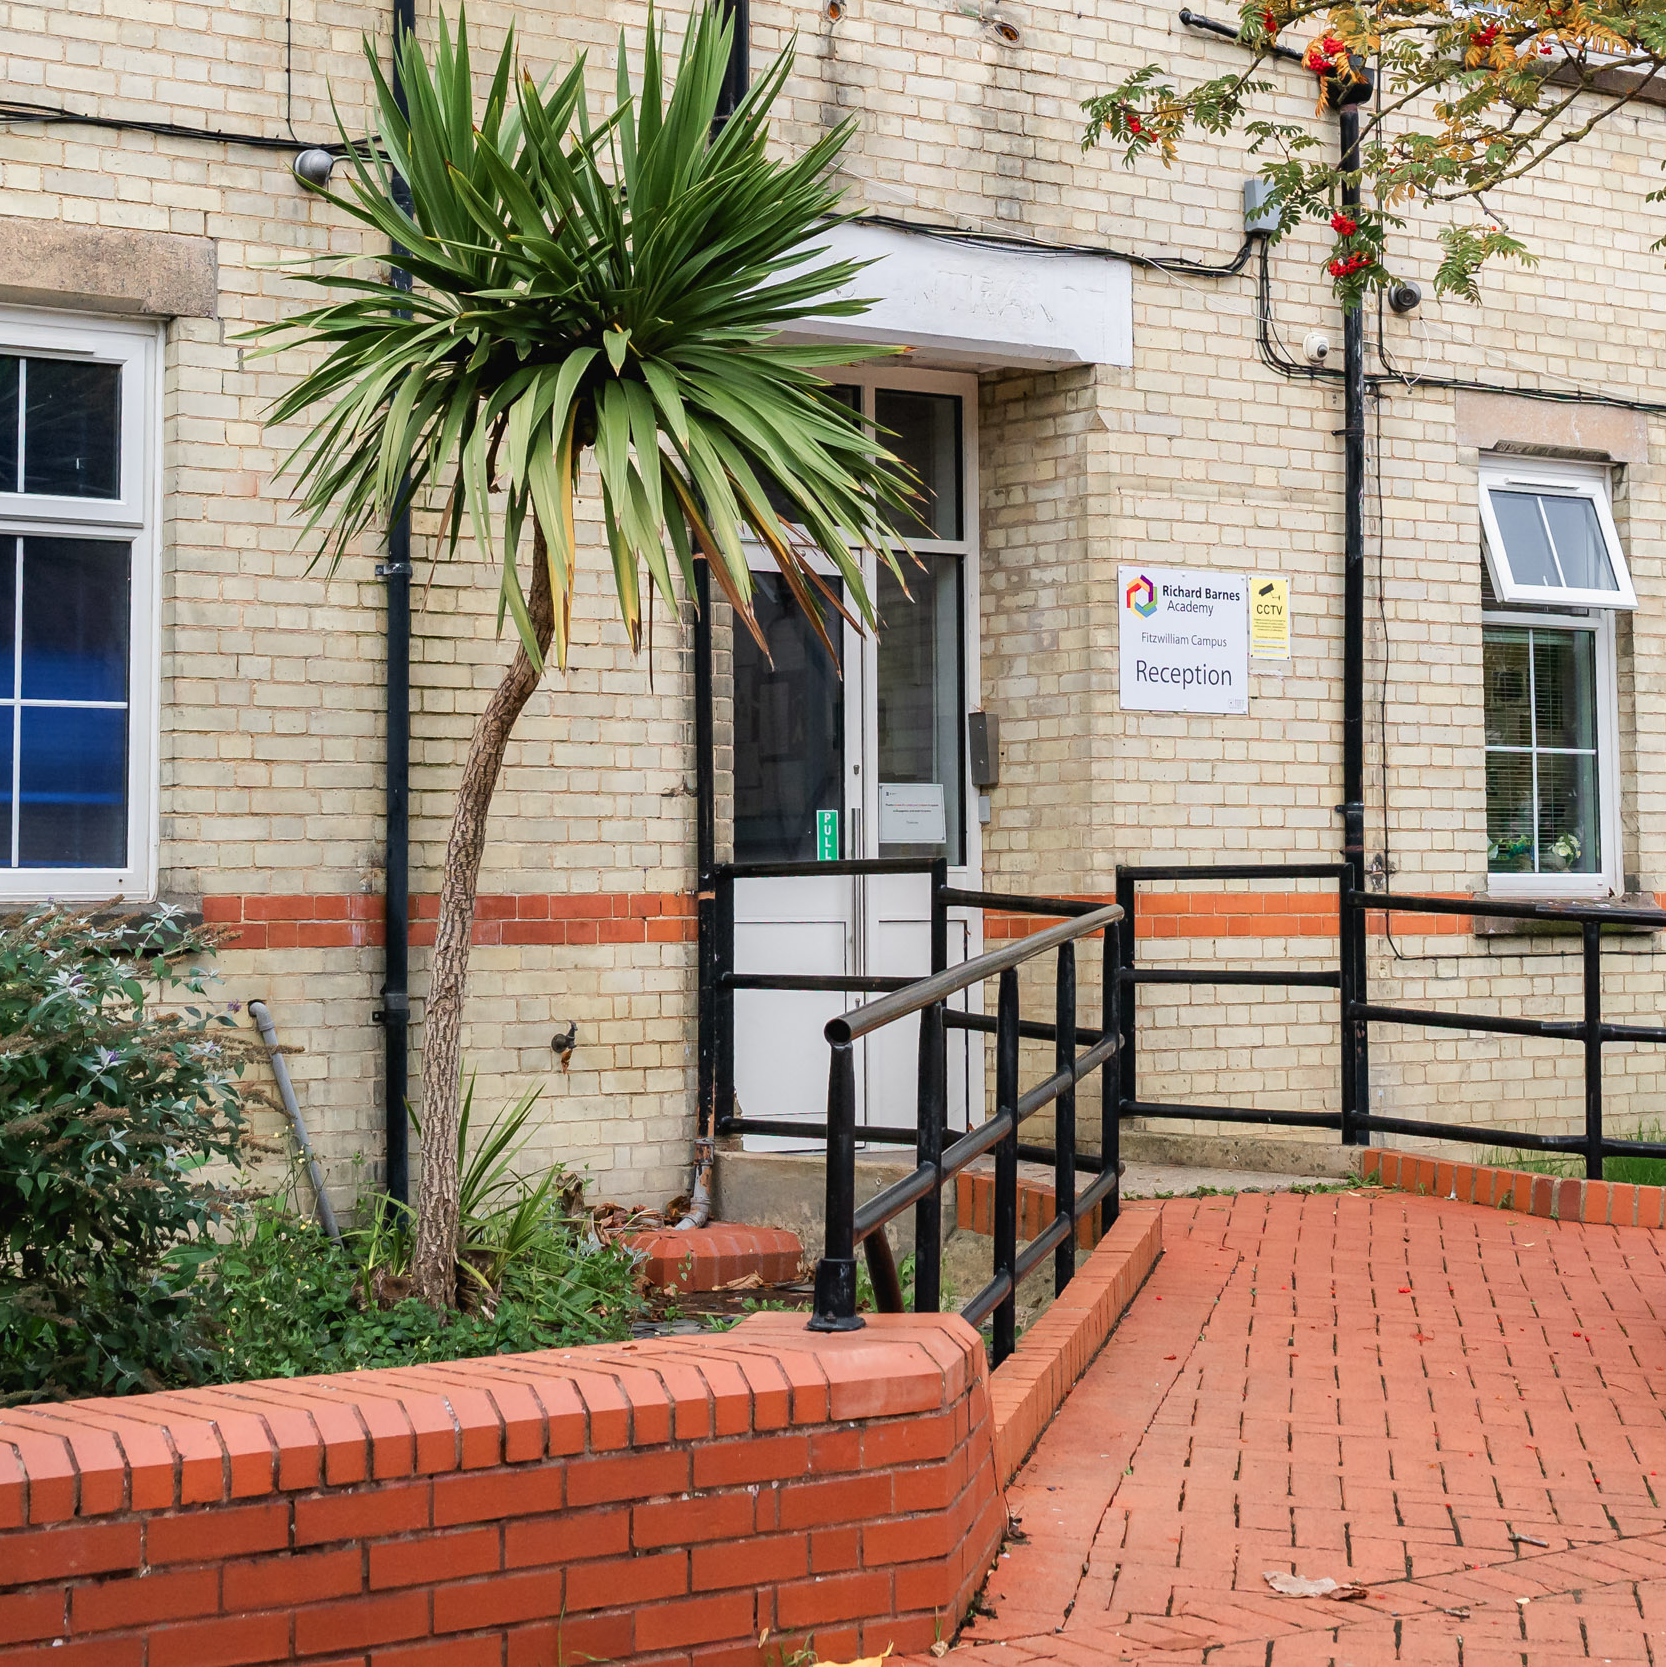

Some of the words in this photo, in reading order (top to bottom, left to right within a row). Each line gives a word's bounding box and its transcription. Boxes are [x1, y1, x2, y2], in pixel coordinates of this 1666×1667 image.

[1162, 585, 1202, 598] Richard
[1205, 588, 1241, 602] Barnes
[1167, 599, 1214, 617] Academy
[1256, 604, 1283, 616] CCTV
[1141, 632, 1189, 646] Fitzwilliam
[1191, 634, 1228, 649] Campus
[1136, 660, 1232, 690] Reception
[824, 813, 832, 860] PULL
